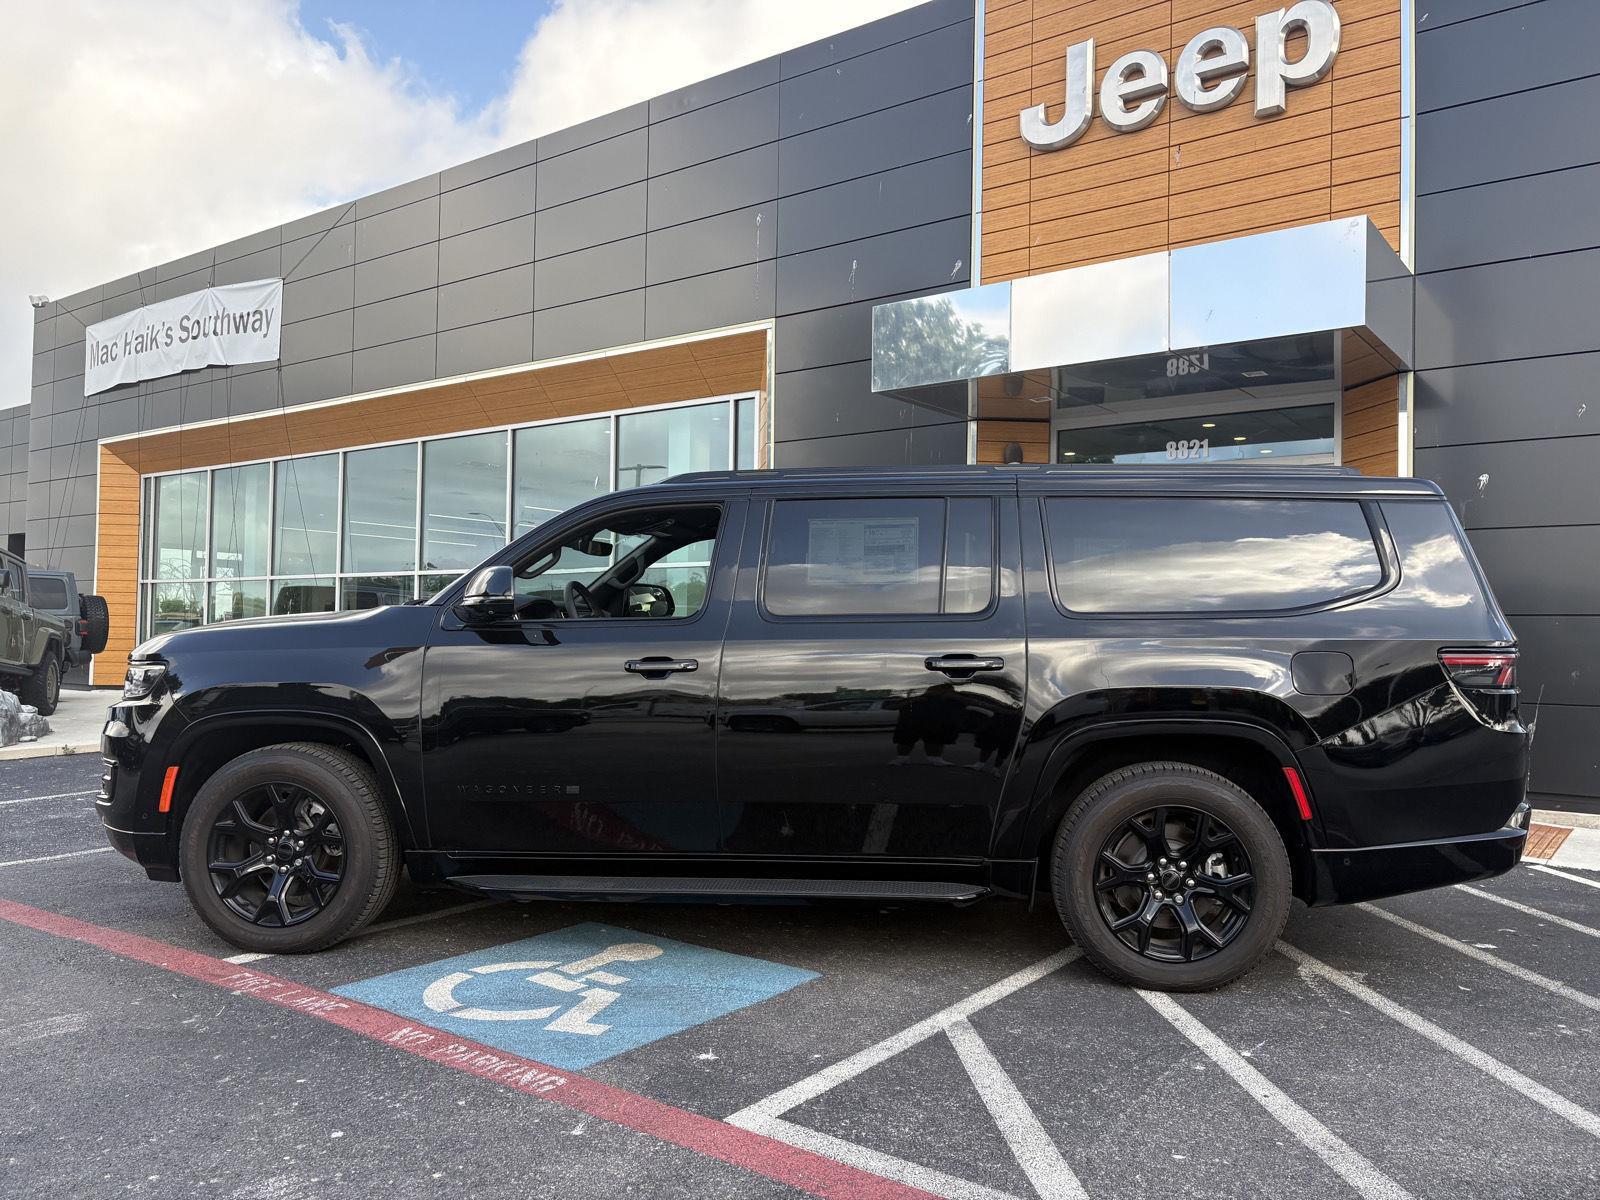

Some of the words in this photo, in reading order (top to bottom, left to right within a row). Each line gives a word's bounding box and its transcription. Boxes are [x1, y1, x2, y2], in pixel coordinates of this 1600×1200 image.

[1019, 0, 1342, 151] Jeep
[89, 340, 118, 369] Mac
[123, 321, 174, 358] Haik's
[178, 307, 274, 345] Southway
[1166, 438, 1210, 460] 8821
[457, 784, 561, 794] WAGONEER
[430, 1042, 568, 1094] PARKING
